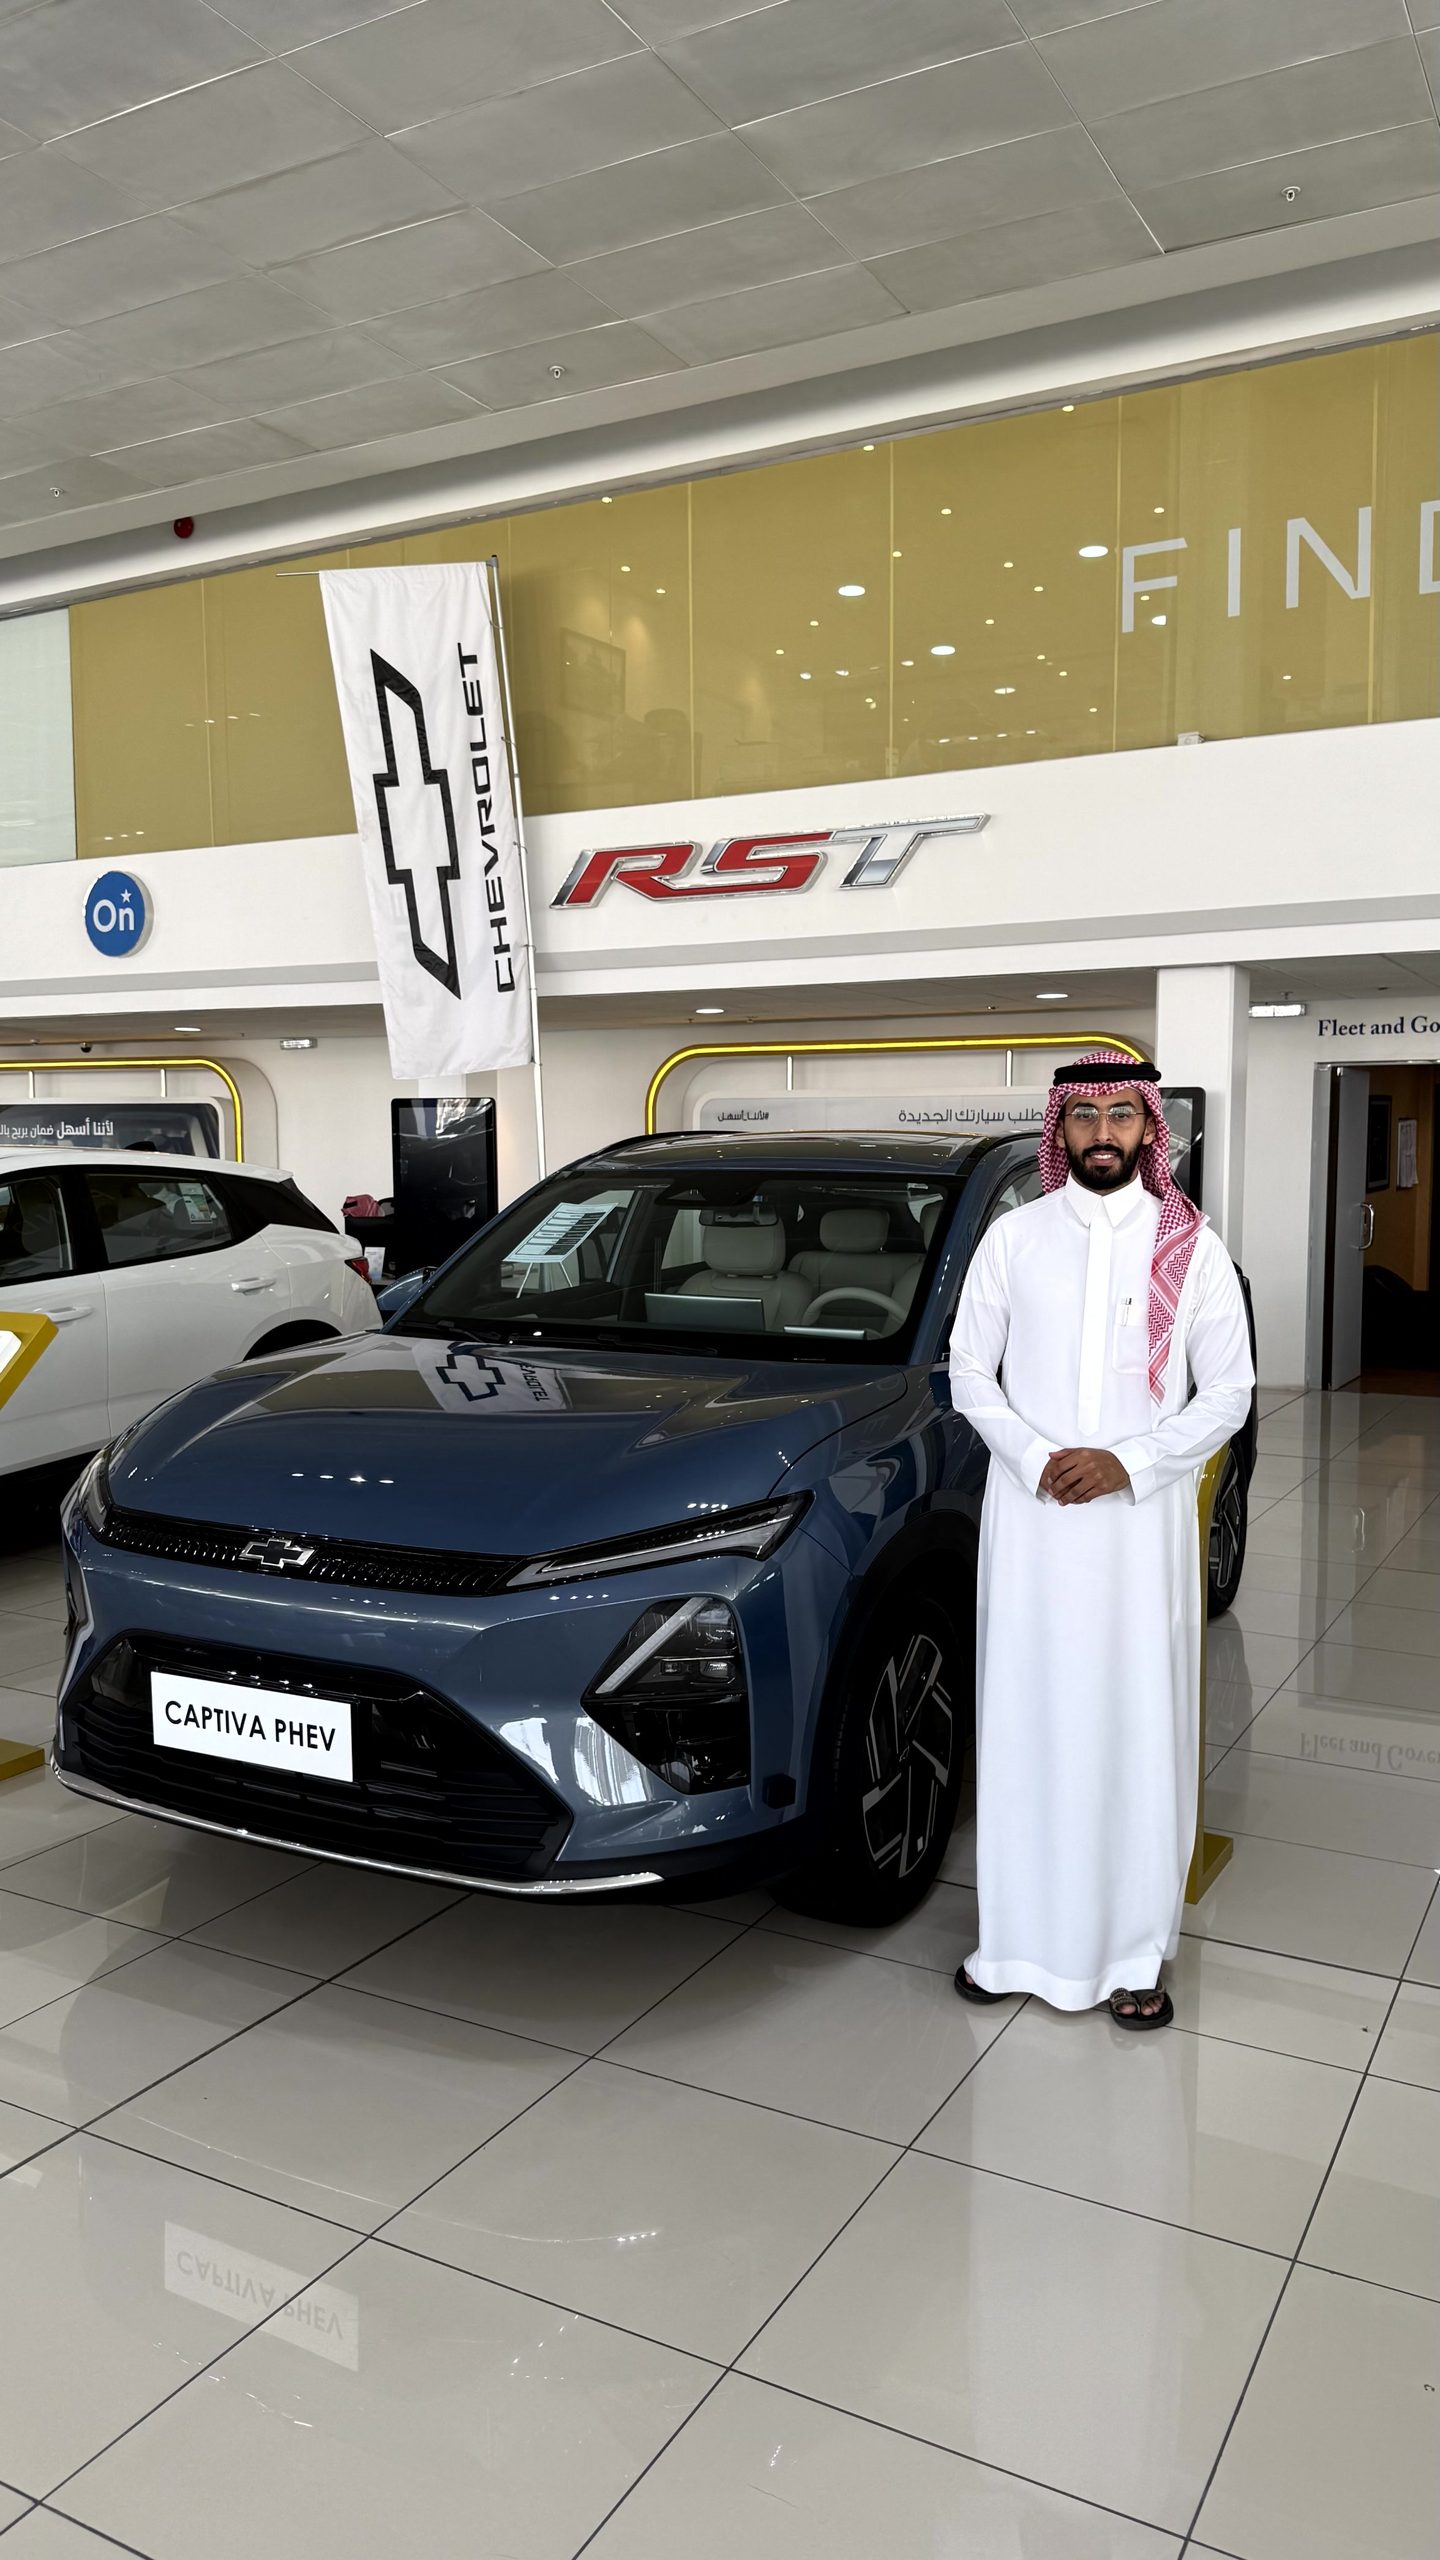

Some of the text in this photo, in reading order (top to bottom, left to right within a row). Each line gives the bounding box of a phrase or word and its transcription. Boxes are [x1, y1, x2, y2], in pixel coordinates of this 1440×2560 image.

[1122, 500, 1440, 633] FIN
[457, 642, 515, 992] CHEVROLET
[549, 813, 991, 909] RST
[93, 899, 135, 933] On
[1318, 1015, 1440, 1036] Fleet and Go
[0, 1117, 114, 1140] لأننا أسهل ضمان يريح بال
[898, 1108, 1046, 1125] طلب سيارتك الجديدة
[165, 1701, 336, 1752] CAPTIVA PHEV
